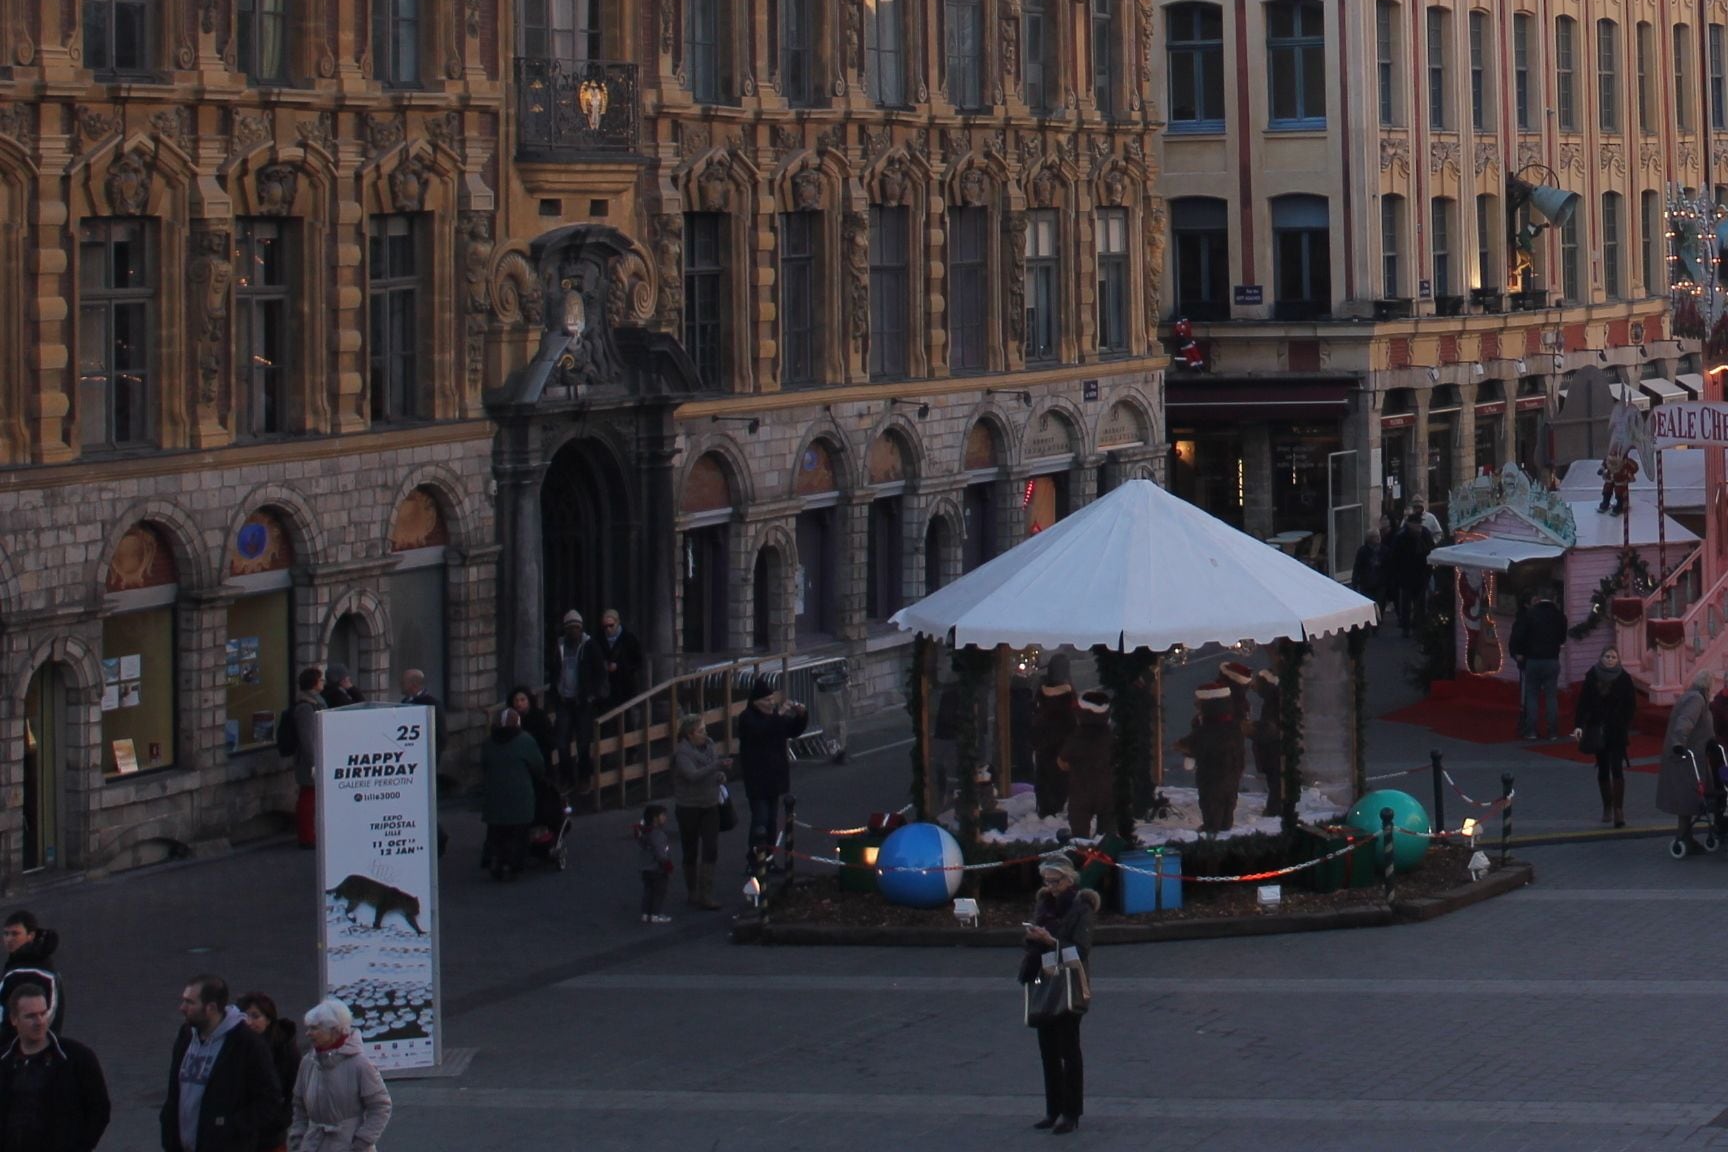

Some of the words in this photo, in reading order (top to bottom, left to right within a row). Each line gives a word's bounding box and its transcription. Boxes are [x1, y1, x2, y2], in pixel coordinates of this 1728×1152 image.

[396, 725, 421, 741] 25
[348, 752, 403, 765] HAPPY
[334, 764, 417, 779] BIRTHDAY
[338, 779, 370, 789] GALERIE
[374, 777, 414, 787] PERROTIN
[365, 792, 400, 800] lille3000
[382, 814, 403, 822] EXPO
[370, 821, 415, 830] TRIPOSTAL
[380, 848, 392, 856] 12
